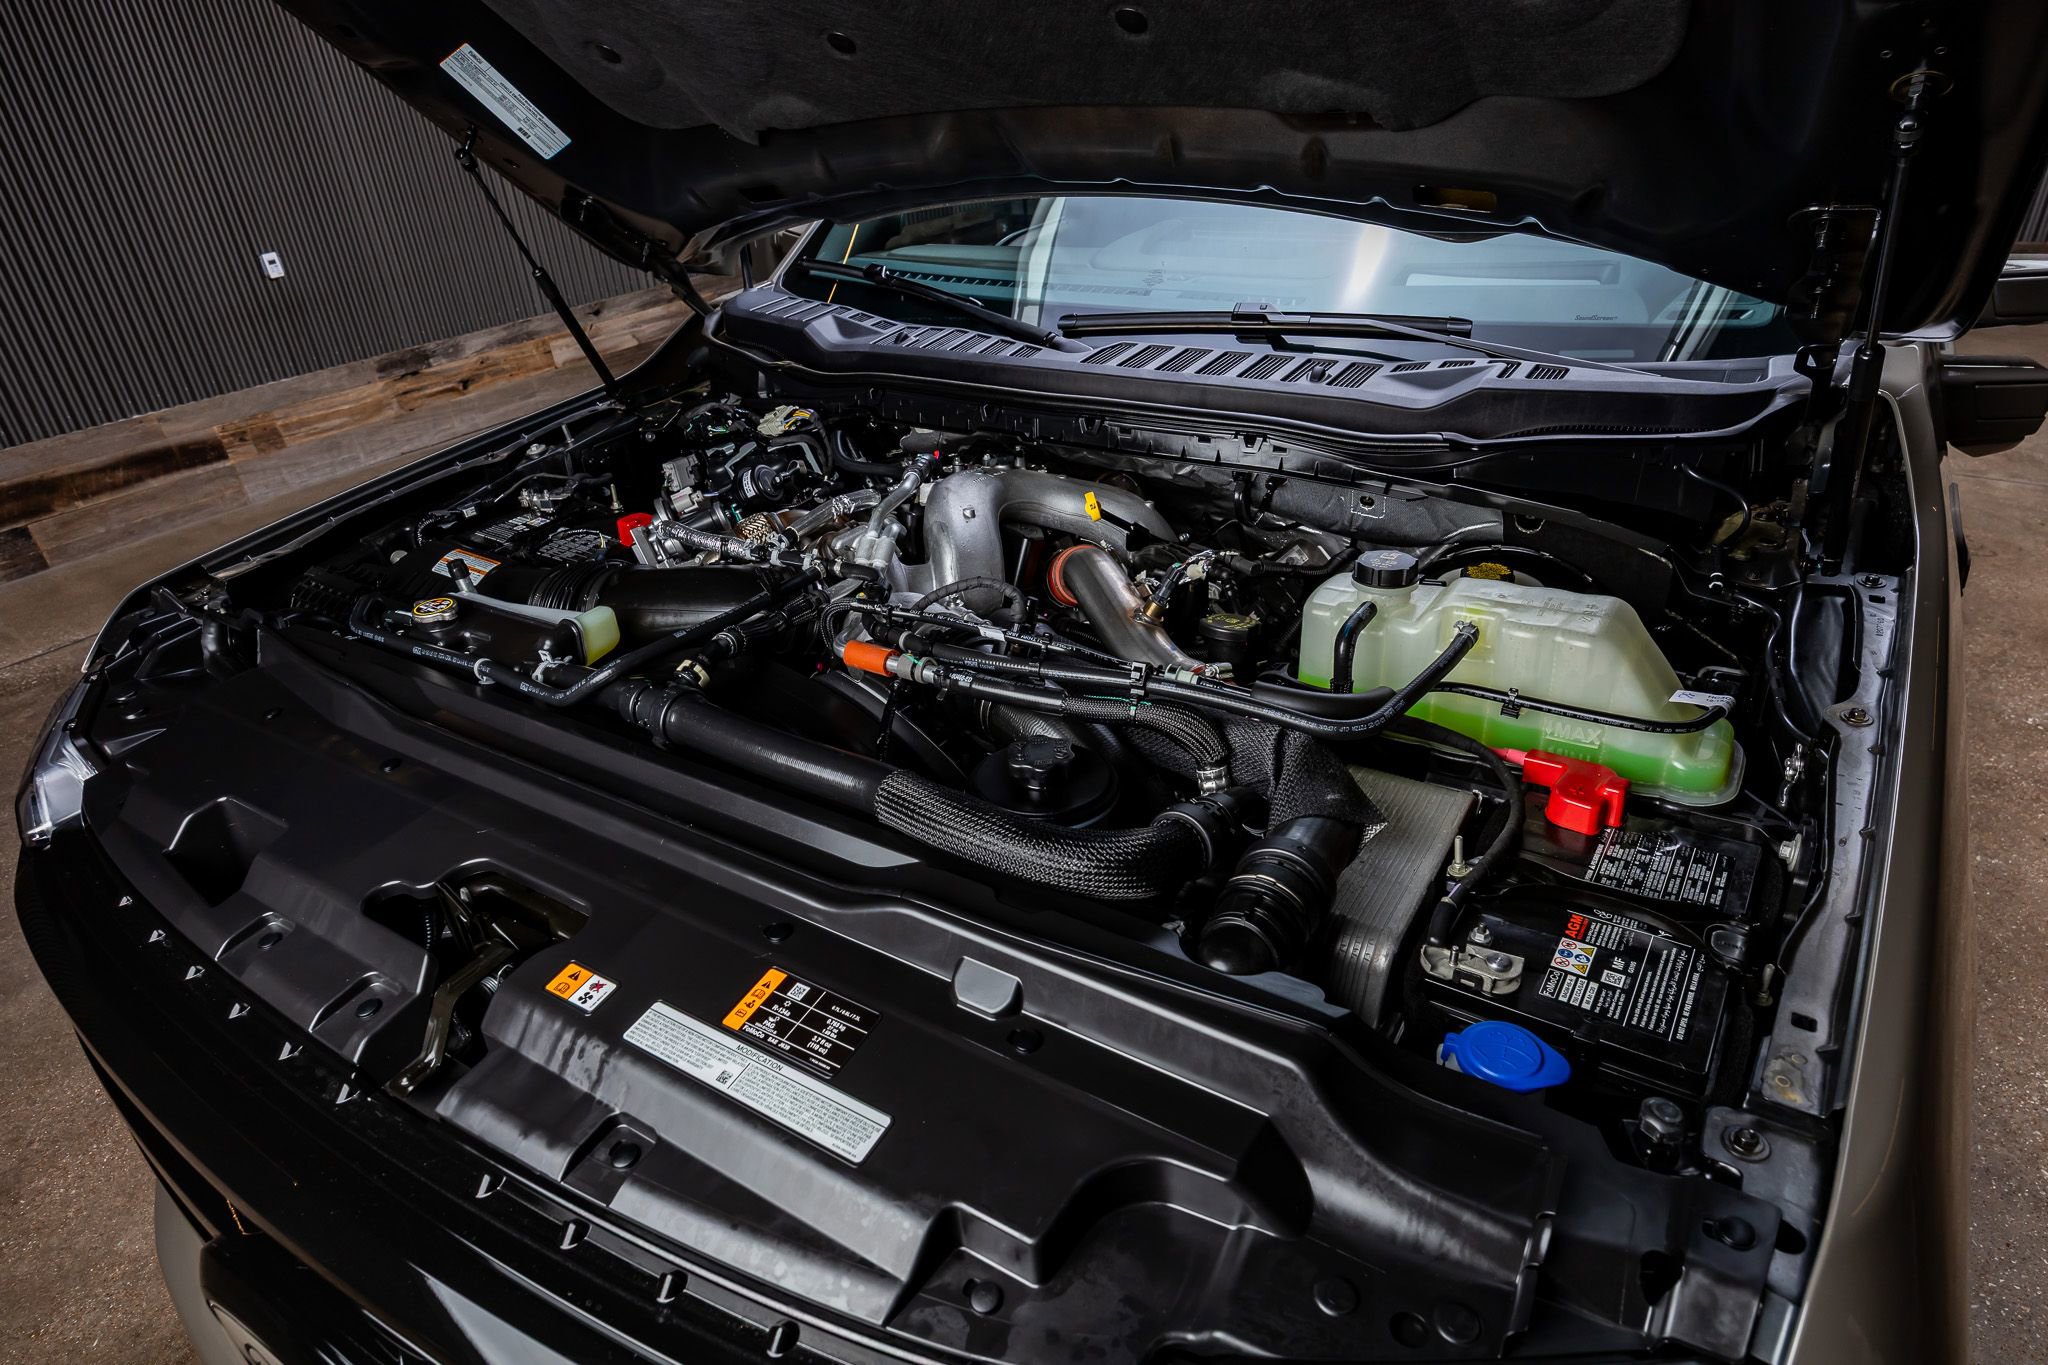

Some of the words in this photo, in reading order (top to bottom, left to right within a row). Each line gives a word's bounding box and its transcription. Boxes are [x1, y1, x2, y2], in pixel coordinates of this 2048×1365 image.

[1554, 722, 1602, 745] MAX
[1566, 915, 1583, 938] AGM
[1612, 957, 1625, 970] MF
[1544, 970, 1560, 996] FoMoCo
[772, 1005, 790, 1016] R-134a
[743, 1025, 764, 1038] FoMoCo
[763, 1020, 775, 1028] PAG
[736, 1045, 783, 1071] MODIFICATION
